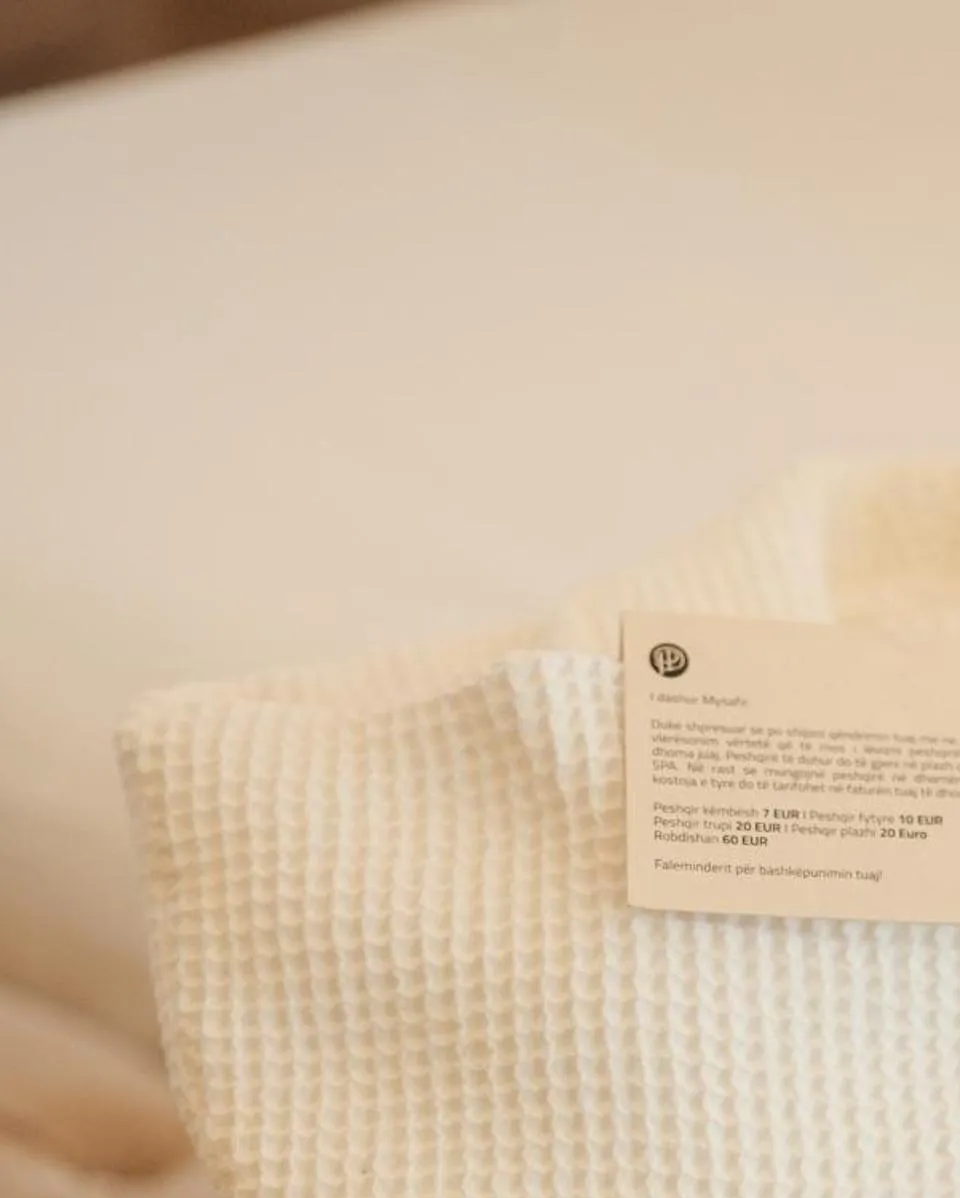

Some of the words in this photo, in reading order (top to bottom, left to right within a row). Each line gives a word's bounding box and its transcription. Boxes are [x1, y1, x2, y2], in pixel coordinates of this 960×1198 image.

[763, 808, 770, 819] 7
[773, 808, 800, 820] EUR
[899, 814, 914, 826] 10
[917, 815, 944, 827] EUR
[735, 820, 751, 832] 20
[754, 821, 781, 834] EUR
[880, 827, 896, 839] 20
[899, 828, 928, 840] Euro
[721, 834, 739, 846] 60
[742, 834, 768, 847] EUR
